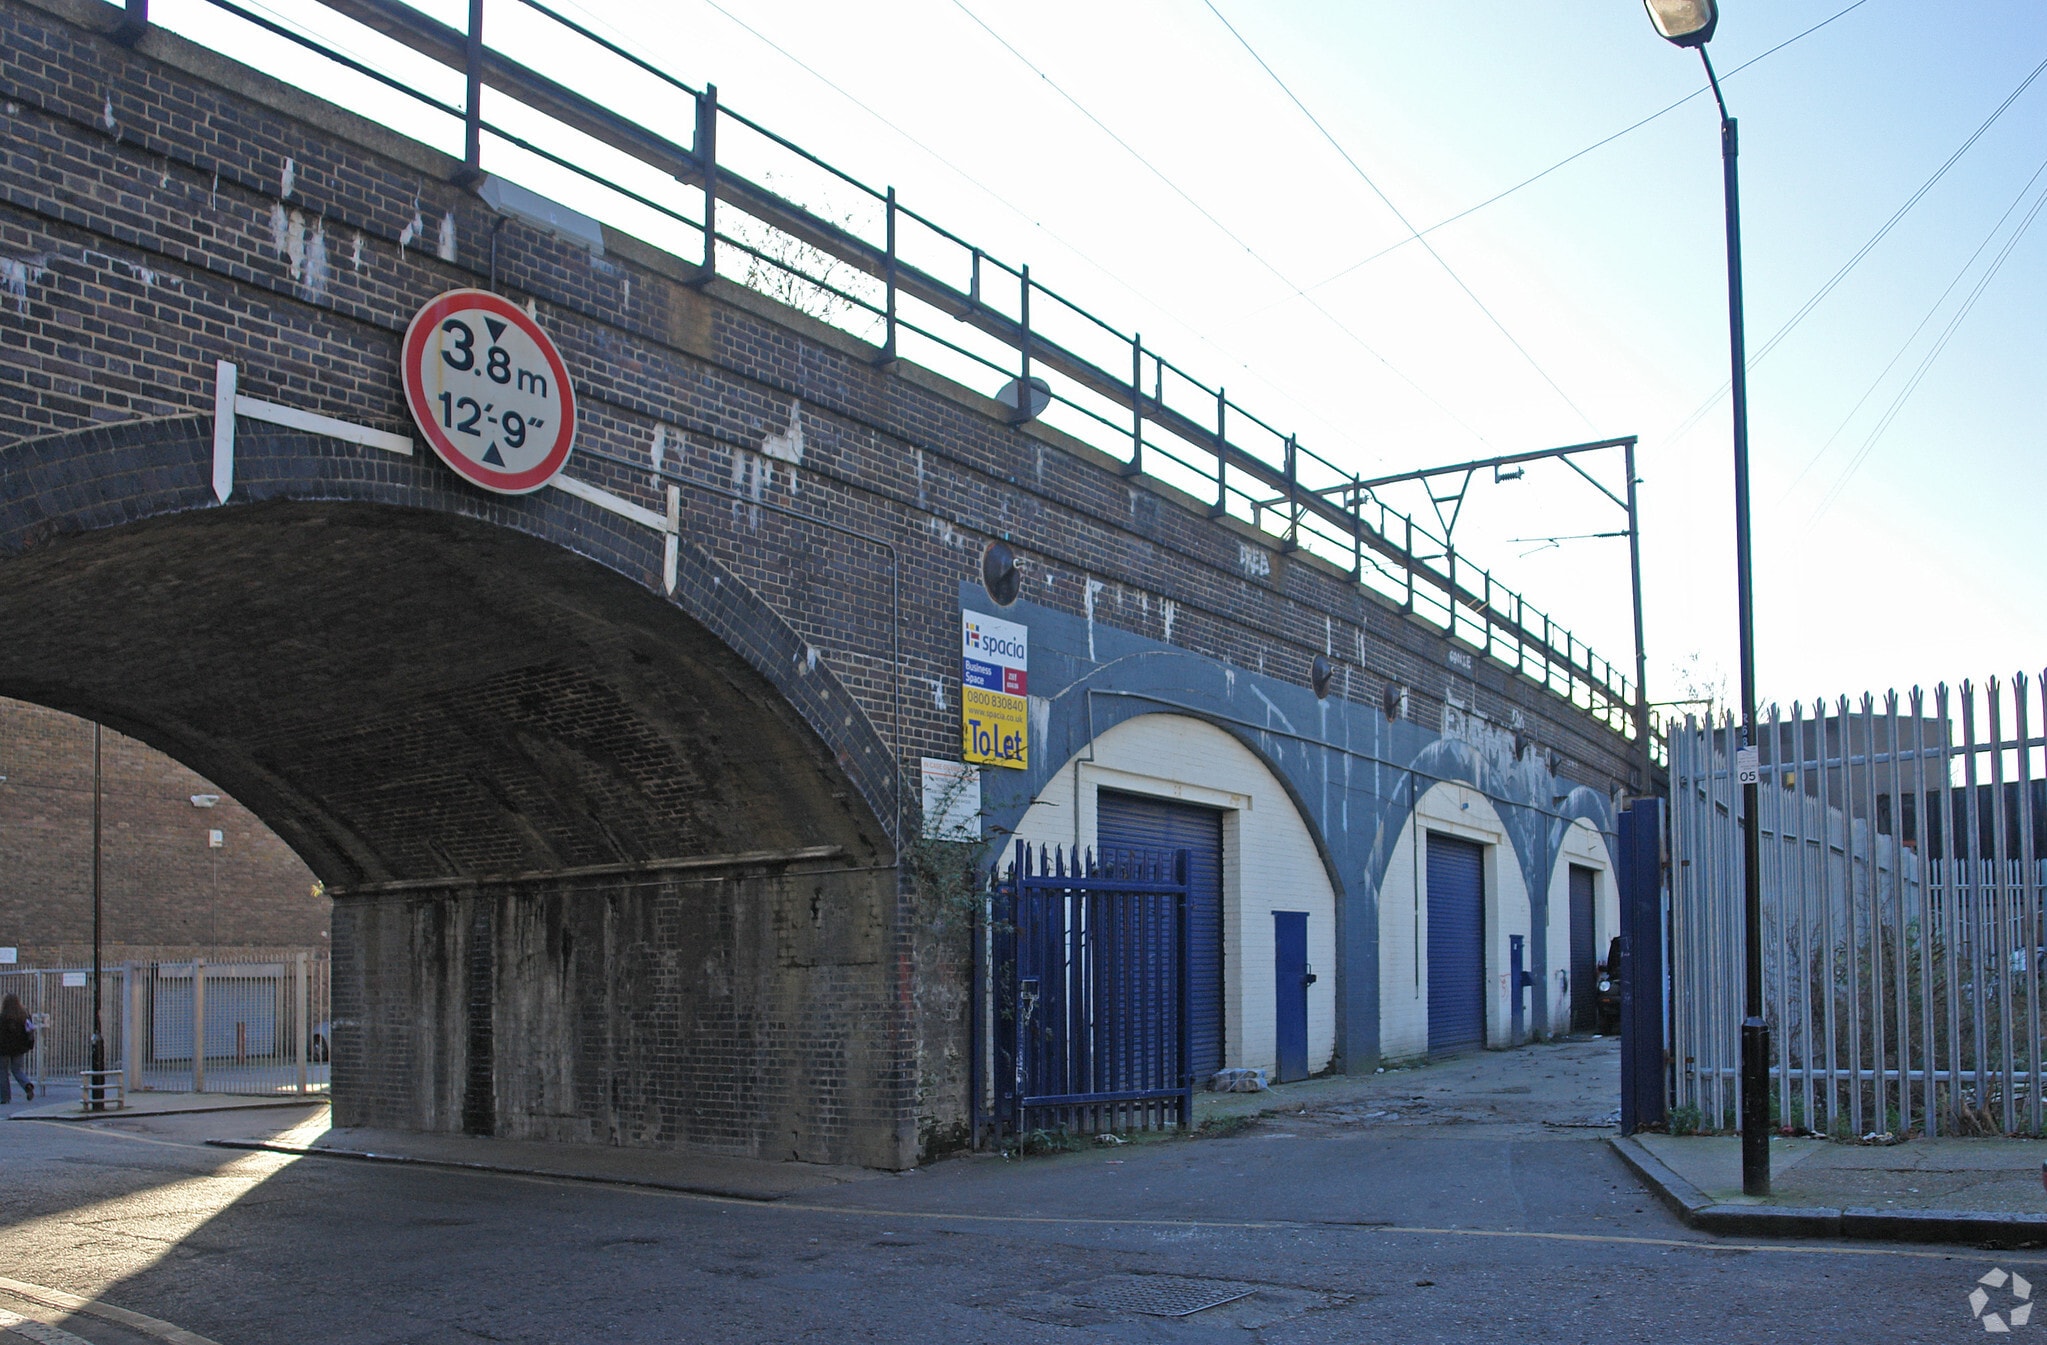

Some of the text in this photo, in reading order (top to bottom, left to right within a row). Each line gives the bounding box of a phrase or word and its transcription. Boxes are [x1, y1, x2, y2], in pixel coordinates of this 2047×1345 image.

[982, 634, 1025, 660] spacia
[965, 660, 992, 676] Business
[965, 671, 985, 685] Space
[968, 690, 1024, 712] 0800 830840
[968, 707, 1023, 723] www.spacia.co.uk
[968, 718, 1023, 761] To Let
[1740, 771, 1756, 781] 05
